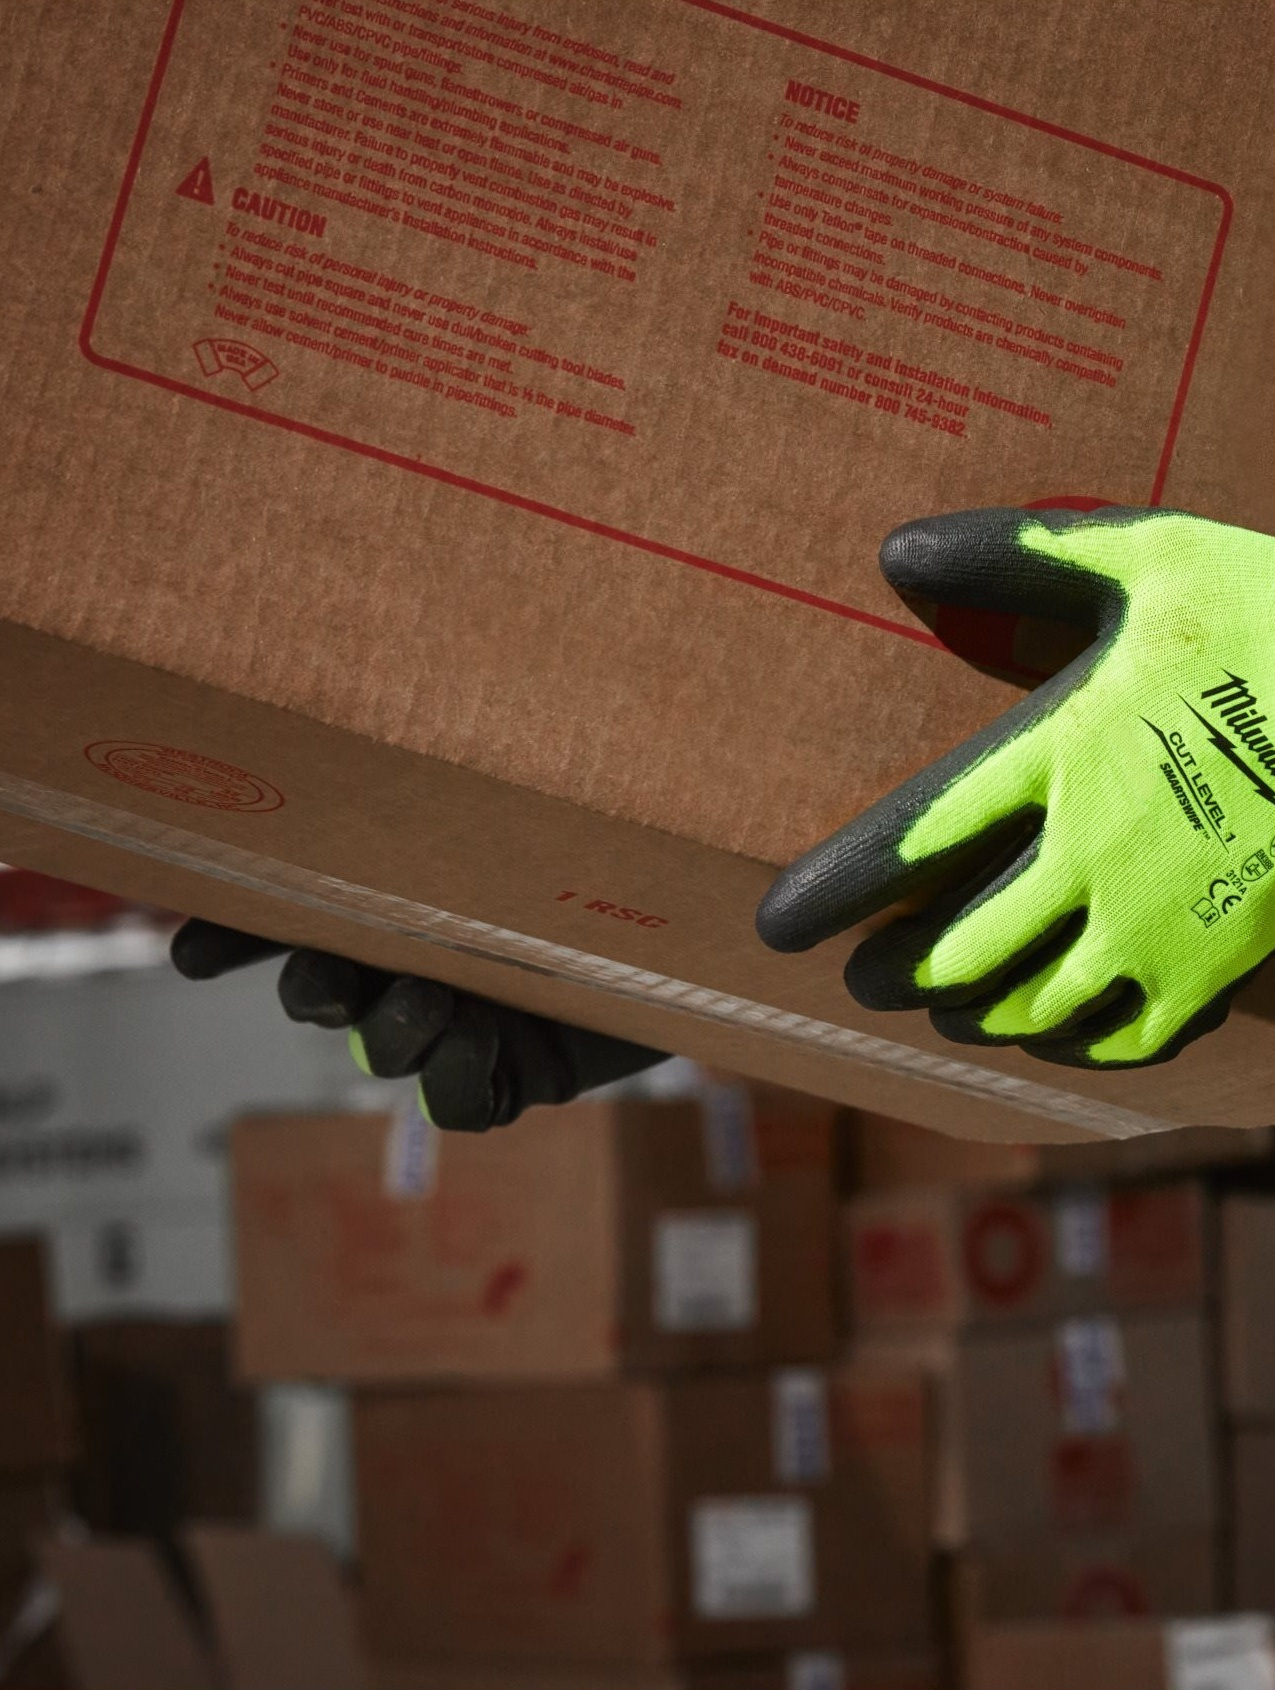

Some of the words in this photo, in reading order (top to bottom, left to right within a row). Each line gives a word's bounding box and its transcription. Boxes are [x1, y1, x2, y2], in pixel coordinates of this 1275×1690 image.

[297, 5, 392, 48] PVC/ABS/CPVC
[287, 43, 312, 62] Use
[310, 54, 339, 74] only
[340, 62, 358, 78] for
[359, 69, 388, 89] fluid
[388, 79, 497, 130] handling/plumbing
[785, 80, 860, 124] NOTICE
[253, 163, 312, 190] appliance
[309, 182, 400, 222] manufacturer's
[774, 174, 842, 208] temperature
[779, 113, 794, 128] To
[793, 121, 835, 142] reduce
[835, 135, 858, 151] risk
[858, 143, 874, 156] of
[870, 149, 923, 175] property
[920, 165, 968, 190] damage
[967, 183, 982, 194] or
[982, 188, 1027, 209] system
[783, 135, 817, 157] Never
[819, 150, 859, 172] exceed
[860, 164, 917, 193] maximum
[916, 185, 964, 212] working
[964, 203, 1014, 228] pressure
[1015, 220, 1029, 232] of
[1029, 226, 1051, 242] any
[1052, 232, 1093, 255] system
[231, 187, 327, 238] CAUTION
[763, 211, 814, 239] threaded
[777, 155, 819, 179] Always
[820, 171, 890, 204] compensate
[889, 194, 909, 209] for
[909, 203, 1030, 254] expansion/contraction
[1031, 247, 1072, 269] caused
[1073, 259, 1088, 276] by
[225, 222, 240, 237] To
[240, 230, 283, 251] reduce
[283, 244, 308, 260] risk
[308, 252, 325, 265] of
[320, 255, 378, 283] personal
[412, 289, 428, 300] or
[427, 294, 479, 320] property
[749, 271, 773, 287] with
[758, 230, 784, 250] Pipe
[786, 243, 801, 255] or
[799, 245, 840, 270] fittings
[842, 263, 868, 281] may
[869, 269, 884, 285] be
[885, 276, 937, 303] damaged
[939, 294, 955, 311] by
[952, 302, 1013, 333] contacting
[1014, 323, 1064, 348] products
[1065, 341, 1123, 371] containing
[767, 192, 791, 210] Use
[793, 204, 818, 222] only
[863, 226, 887, 245] tape
[890, 238, 905, 251] on
[907, 241, 956, 268] threaded
[1030, 285, 1062, 306] Never
[1064, 299, 1125, 328] overtighten
[214, 303, 250, 326] Never
[251, 318, 286, 337] allow
[285, 330, 374, 368] cement/primer
[374, 359, 388, 374] to
[388, 366, 431, 388] puddle
[218, 285, 262, 309] Always
[263, 302, 287, 317] use
[287, 310, 332, 333] solvent
[332, 326, 421, 362] cement/primer
[422, 356, 480, 382] applicator
[483, 374, 507, 392] that
[535, 392, 554, 408] the
[555, 401, 582, 418] pipe
[225, 265, 261, 287] Never
[262, 277, 286, 296] test
[286, 288, 315, 306] until
[315, 298, 403, 335] recommended
[400, 328, 429, 345] cure
[431, 335, 464, 357] times
[464, 350, 485, 363] are
[229, 246, 273, 270] Always
[274, 262, 295, 278] cut
[293, 269, 325, 287] pipe
[321, 279, 367, 301] square
[365, 294, 391, 310] and
[392, 303, 425, 321] never
[427, 315, 449, 330] use
[450, 321, 516, 353] dull/broken
[517, 345, 559, 369] cutting
[560, 358, 585, 375] tool
[727, 301, 751, 320] For
[821, 336, 863, 363] safety
[865, 352, 892, 370] and
[890, 297, 922, 321] Verify
[923, 312, 973, 337] products
[974, 330, 993, 344] are
[995, 336, 1054, 367] chemically
[1054, 358, 1116, 387] compatible
[716, 339, 739, 358] fax
[741, 352, 759, 366] on
[761, 356, 817, 385] demand
[819, 377, 872, 404] number
[874, 394, 901, 415] 800
[721, 322, 750, 341] call
[750, 330, 778, 351] 800
[779, 341, 843, 374] 438-6091
[846, 367, 862, 380] or
[863, 372, 913, 399] consult
[915, 387, 969, 417] 24-hour
[1169, 731, 1197, 767] CUT
[1191, 772, 1226, 829] LEVEL
[1225, 832, 1236, 843] 1
[555, 890, 578, 902] 1
[582, 900, 670, 929] RSC
[1208, 878, 1242, 915] CE
[1225, 869, 1248, 895] 3121A
